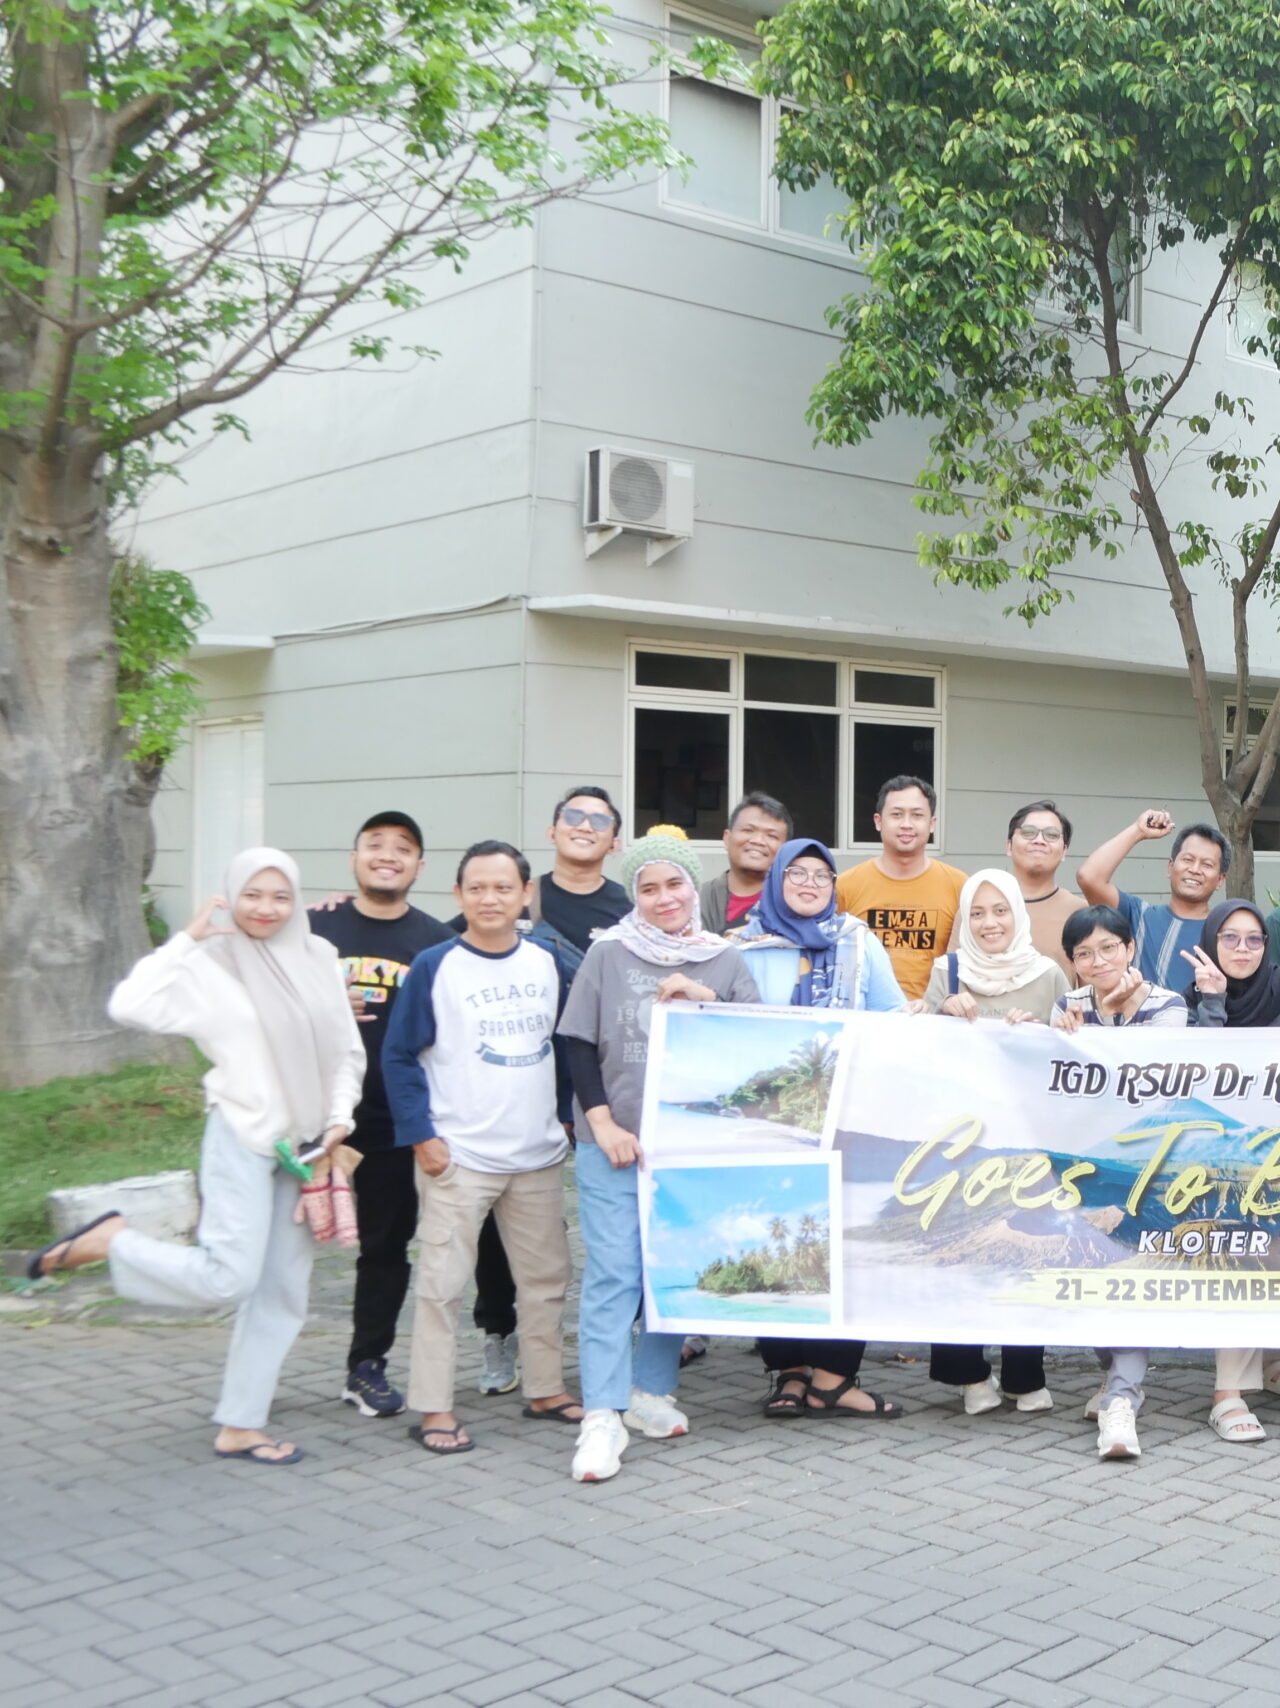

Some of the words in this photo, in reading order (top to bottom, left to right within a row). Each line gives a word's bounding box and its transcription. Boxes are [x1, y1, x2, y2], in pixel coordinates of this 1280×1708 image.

[875, 929, 932, 948] EANS
[1049, 1060, 1107, 1096] IGD
[1116, 1063, 1208, 1104] RSUP
[1213, 1063, 1254, 1097] Dr
[893, 1115, 1096, 1231] Goes
[1112, 1121, 1225, 1218] To
[1137, 1230, 1272, 1256] KLOTER
[1105, 1279, 1137, 1301] 22
